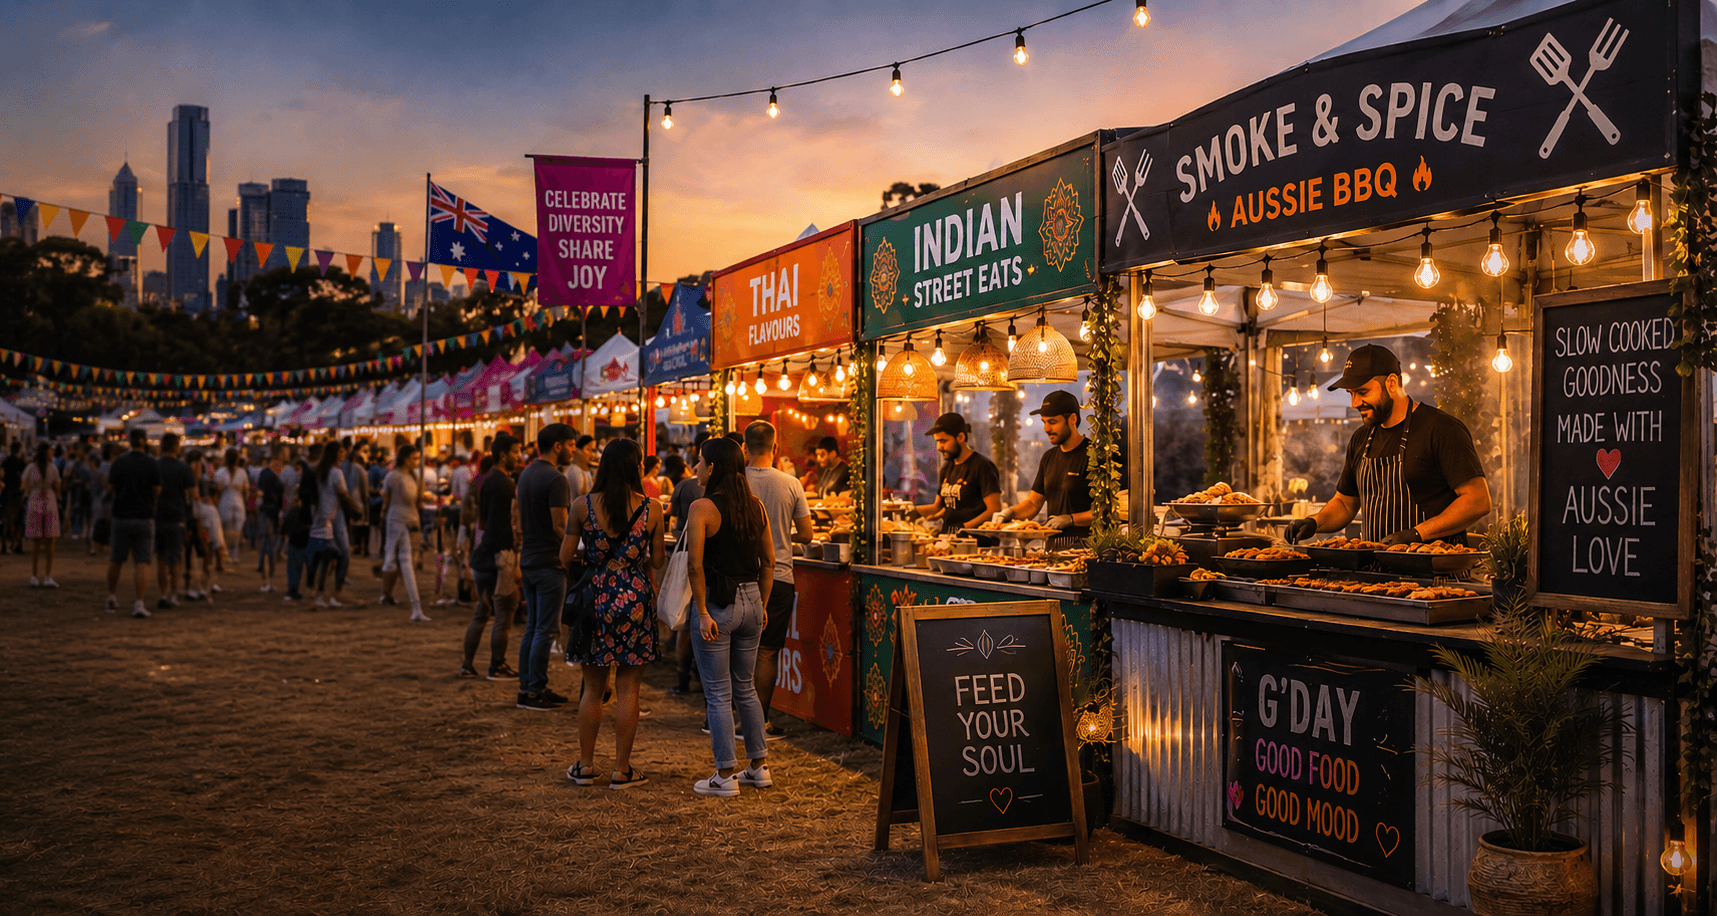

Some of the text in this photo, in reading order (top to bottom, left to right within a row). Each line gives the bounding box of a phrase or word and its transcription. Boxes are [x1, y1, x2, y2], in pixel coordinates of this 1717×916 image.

[1176, 81, 1496, 203] SMOKE & SPICE
[545, 189, 627, 210] CELEBRATE
[1230, 162, 1398, 228] AUSSIE BBQ
[549, 213, 624, 234] DIVERSITY
[914, 191, 1023, 273] INDIAN
[558, 239, 614, 260] SHARE
[567, 264, 607, 290] JOY
[749, 262, 799, 317] THAI
[914, 255, 1023, 309] STREET EATS
[748, 314, 800, 346] FLAVOURS
[1555, 317, 1675, 358] SLOW COOKED
[1563, 360, 1662, 398] GOODNESS
[1557, 410, 1662, 443] MADE WITH
[1562, 485, 1656, 526] AUSSIE
[1572, 535, 1641, 577] LOVE
[954, 672, 1026, 707] FEED
[1258, 674, 1361, 746] G'DAY
[956, 708, 1030, 740] YOUR
[962, 743, 1035, 777] SOUL
[1255, 738, 1360, 796] GOOD FOOD
[1255, 783, 1359, 844] GOOD MOOD
